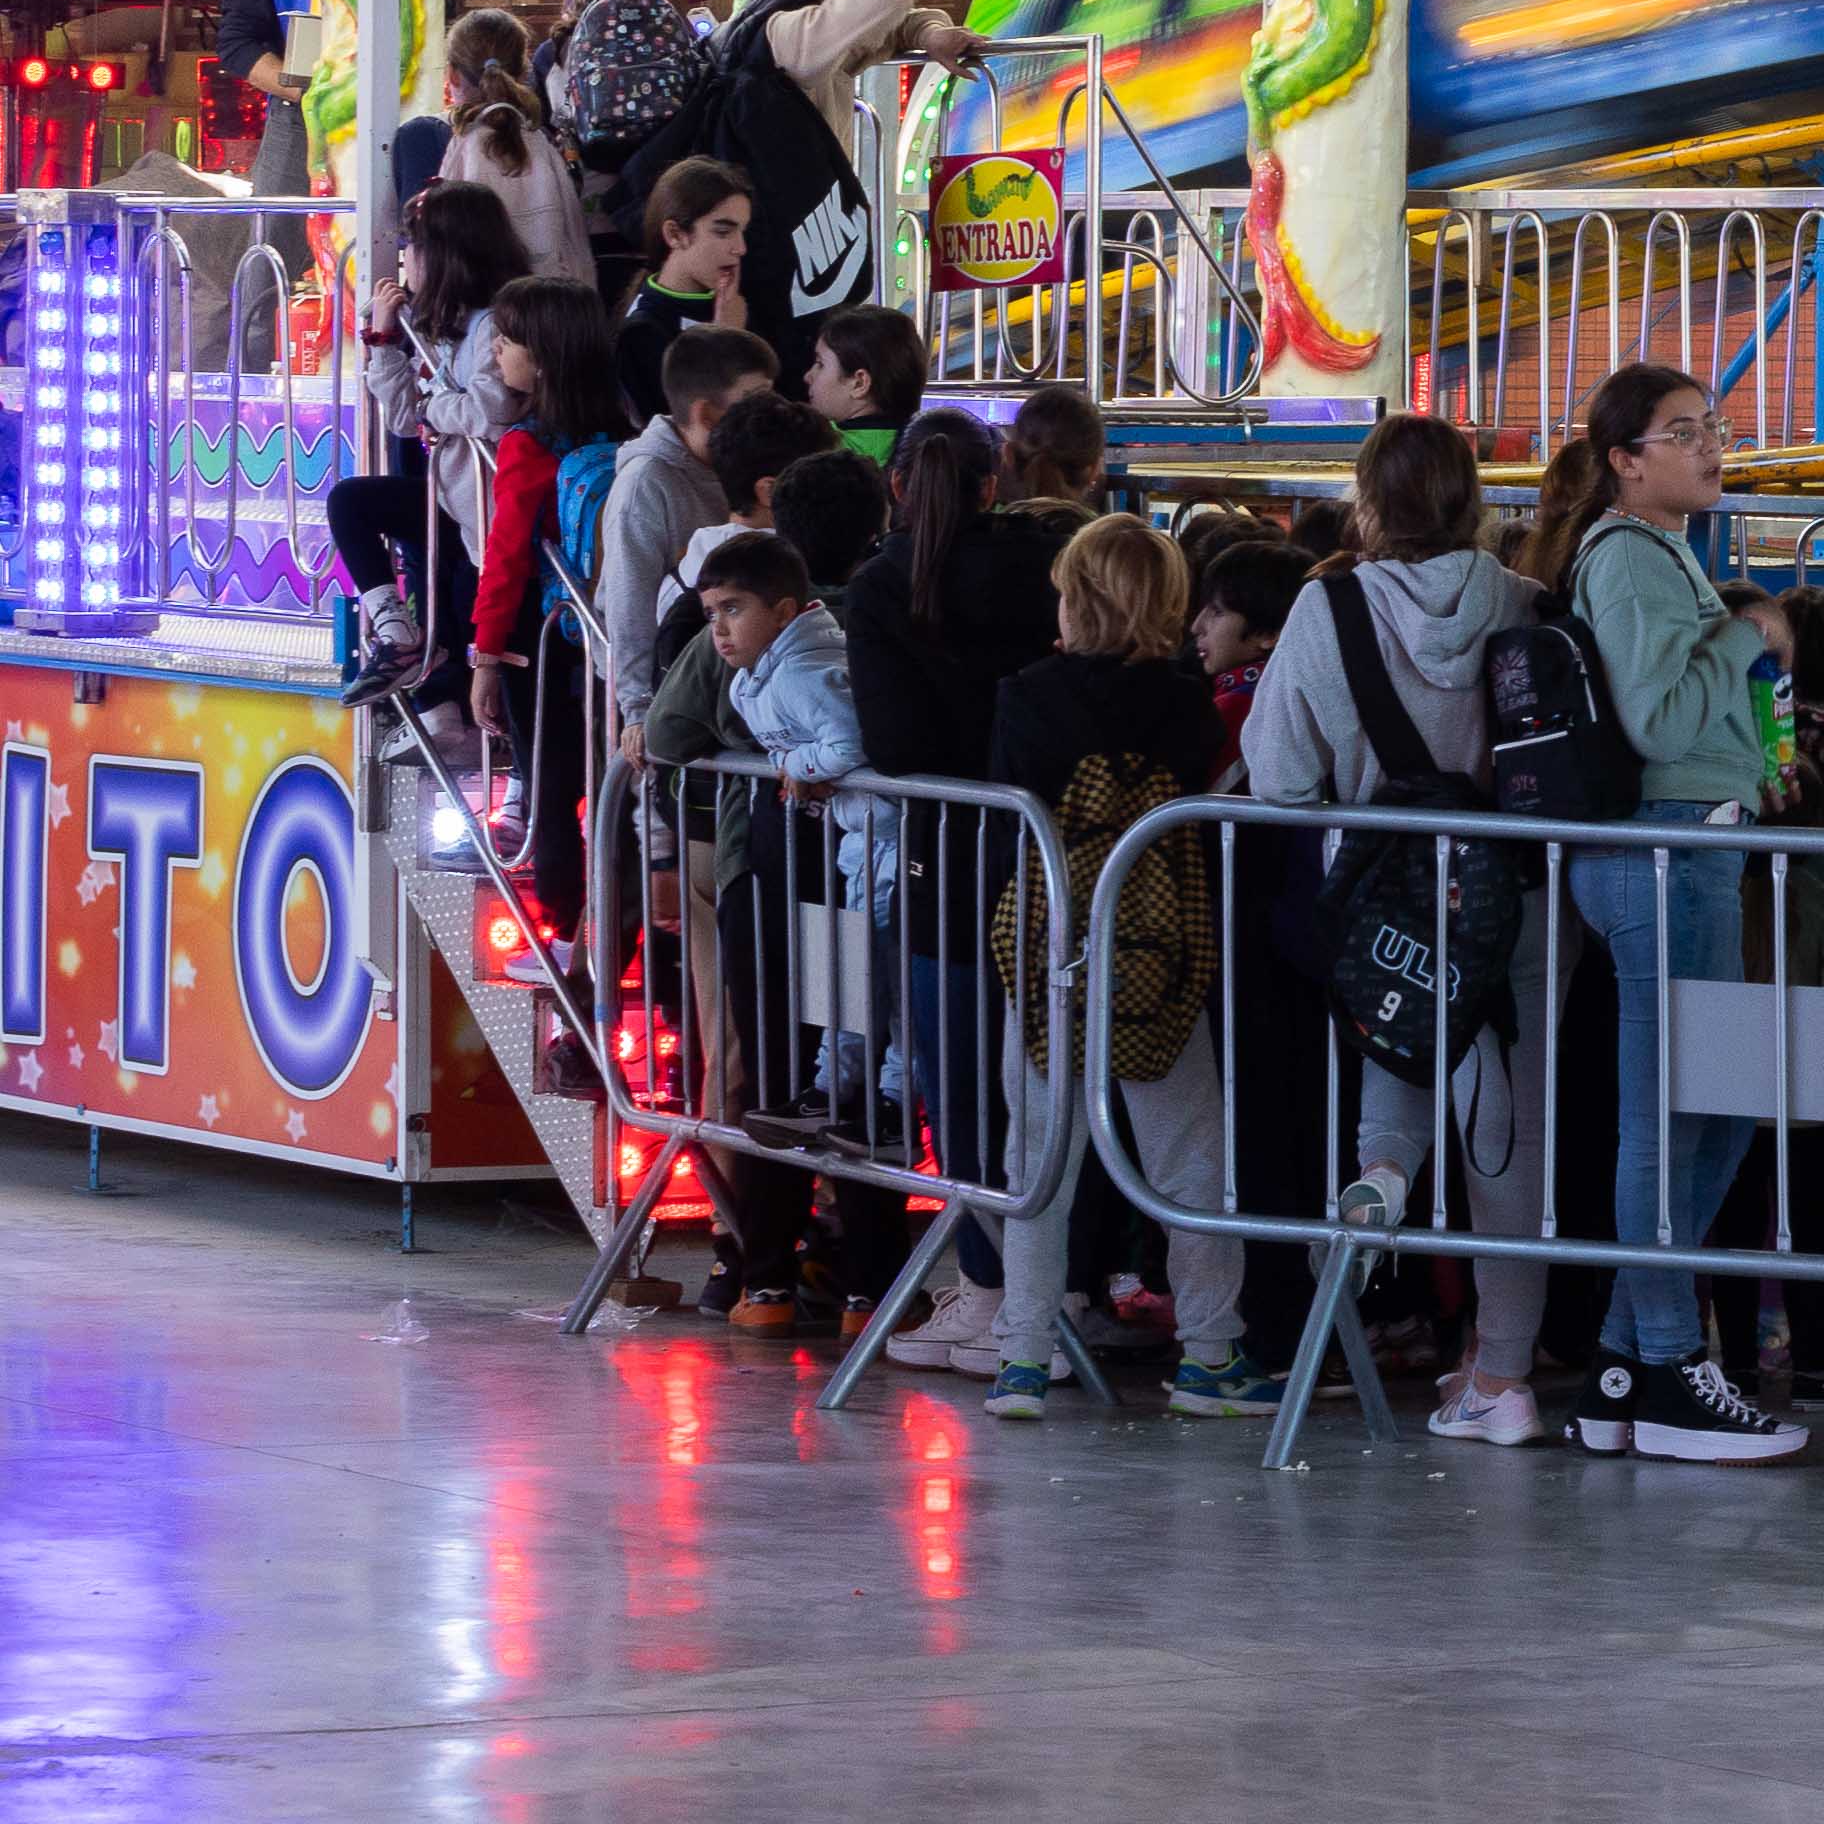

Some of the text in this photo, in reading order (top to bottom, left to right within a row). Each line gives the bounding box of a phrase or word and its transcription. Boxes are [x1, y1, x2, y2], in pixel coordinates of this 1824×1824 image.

[792, 179, 861, 288] NIK
[940, 219, 1052, 264] ENTRADA
[1377, 990, 1402, 1022] 9
